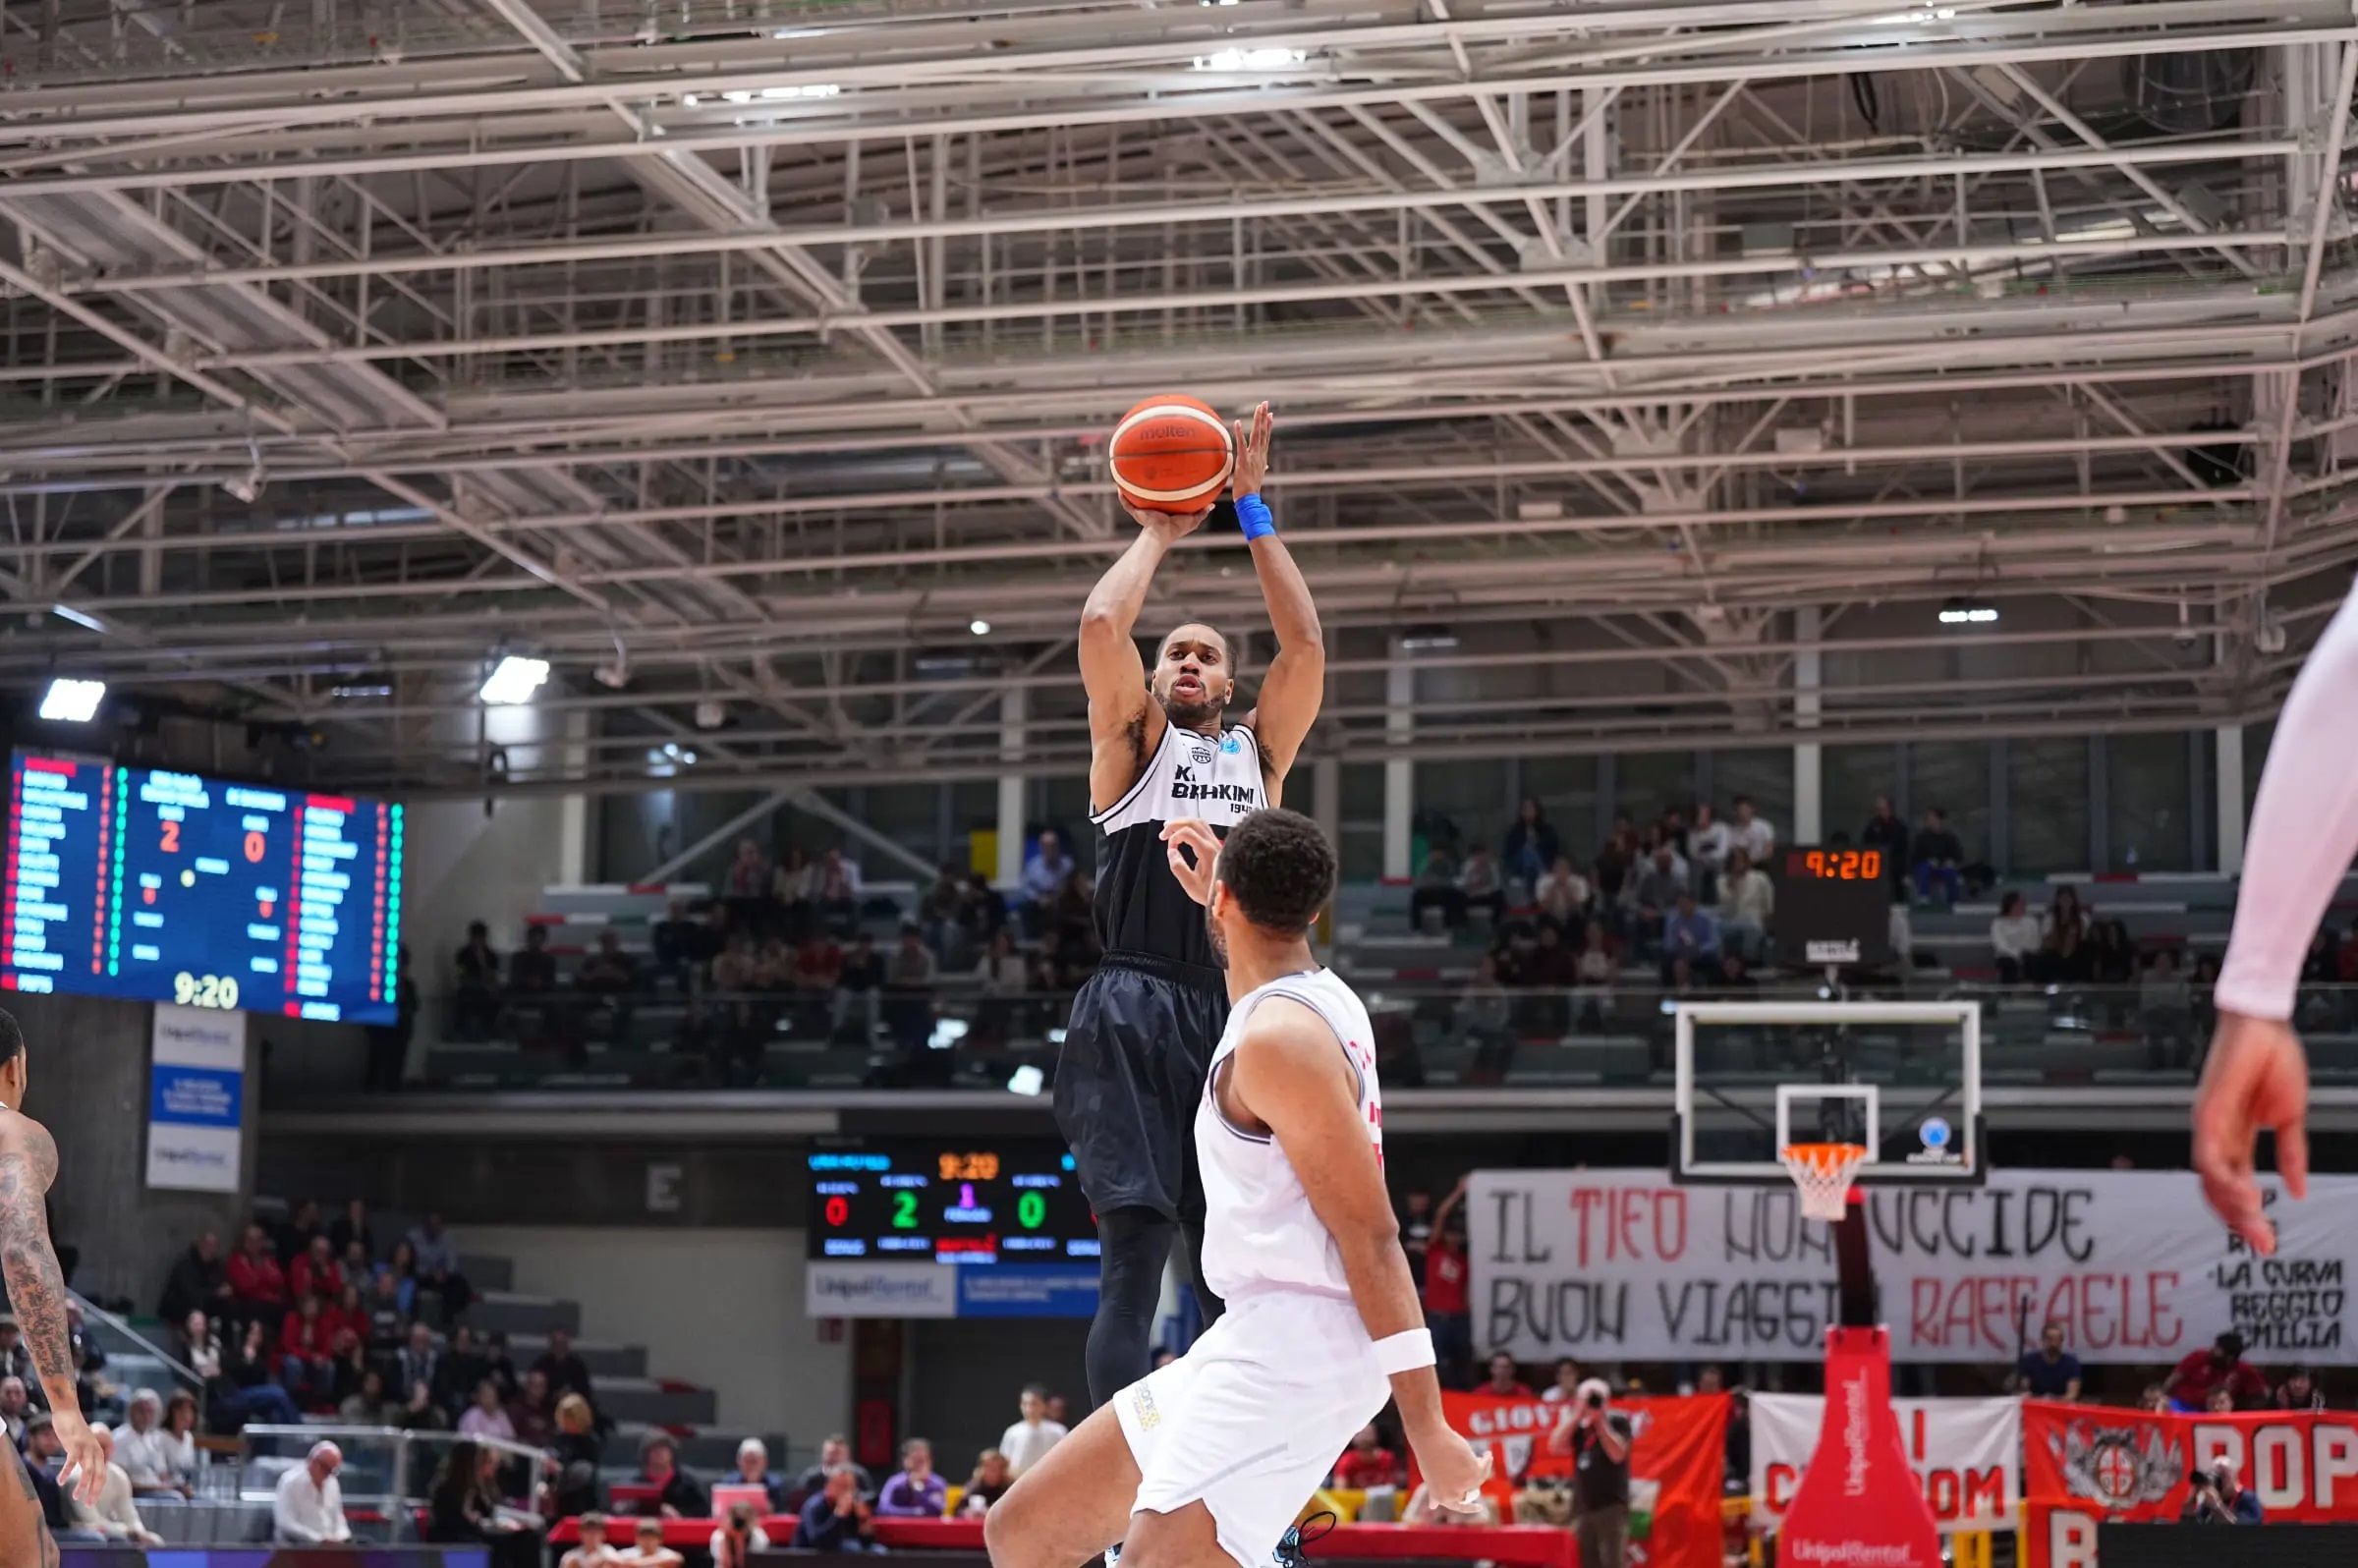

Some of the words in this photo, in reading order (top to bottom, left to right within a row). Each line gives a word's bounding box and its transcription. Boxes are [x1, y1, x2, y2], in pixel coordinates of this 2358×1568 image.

[1140, 424, 1197, 441] molten
[159, 819, 181, 854] 2
[244, 830, 267, 864] 0
[1806, 850, 1881, 880] 9:20
[174, 971, 240, 1011] 9:20
[647, 1166, 681, 1210] E
[959, 1183, 977, 1209] 1
[825, 1195, 850, 1227] 0
[891, 1190, 919, 1229] 2
[1017, 1190, 1046, 1229] 0
[1488, 1190, 1551, 1263] IL
[1570, 1188, 1688, 1268] TIFO
[1871, 1187, 2095, 1264] UCCIDE
[2218, 1260, 2251, 1289] LA
[2262, 1259, 2343, 1290] CURVA
[1488, 1278, 1627, 1349] BUON
[1656, 1278, 1843, 1350] VIAGGI
[1910, 1270, 2183, 1353] RAFFAELE
[2230, 1290, 2345, 1323] REGGIO
